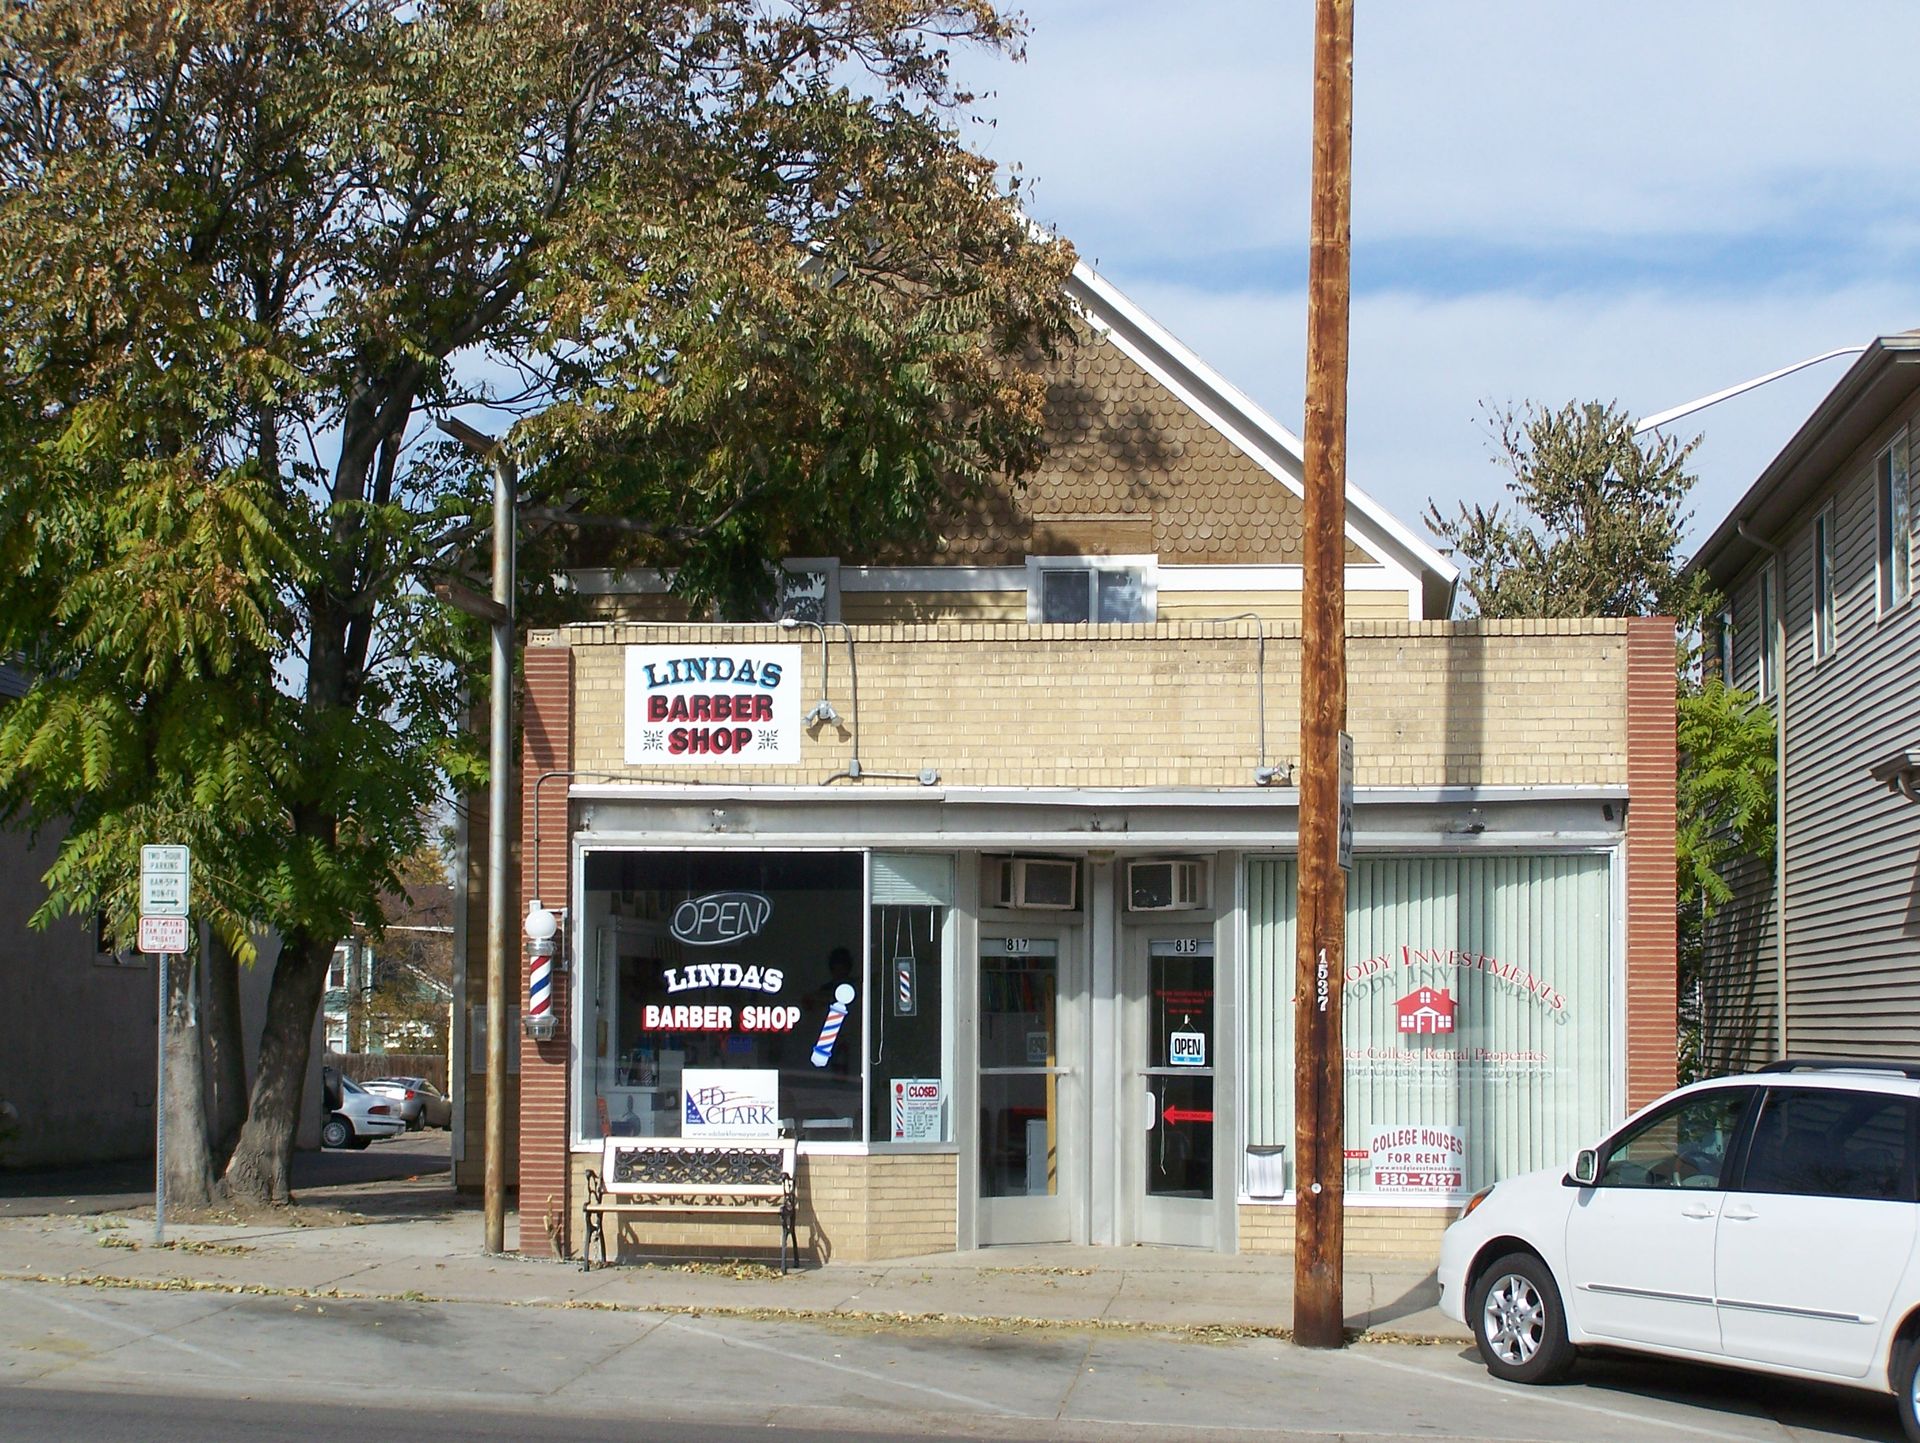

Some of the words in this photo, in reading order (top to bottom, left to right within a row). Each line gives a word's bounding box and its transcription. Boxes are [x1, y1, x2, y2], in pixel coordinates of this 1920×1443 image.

[643, 657, 783, 690] LINDA'S
[648, 694, 774, 722] BARBER
[668, 727, 753, 755] SHOP
[1340, 803, 1352, 854] 25
[148, 852, 160, 860] TWO
[674, 902, 763, 935] OPEN
[1007, 939, 1028, 951] 817
[1175, 940, 1196, 952] 815
[664, 963, 784, 993] LINDA'S
[1317, 948, 1329, 1012] 1537
[1402, 945, 1567, 1010] INVESTMENTS
[643, 1005, 733, 1032] BARBER
[740, 1006, 801, 1032] SHOP
[1174, 1037, 1201, 1056] OPEN
[1367, 1047, 1418, 1064] College
[1425, 1047, 1469, 1061] Rental
[1475, 1048, 1548, 1065] Properties
[700, 1087, 725, 1106] ED
[909, 1086, 938, 1098] CLOSED
[706, 1106, 775, 1124] CLARK
[1372, 1129, 1418, 1153] COLLEGE
[1421, 1129, 1463, 1155] HOUSES
[1387, 1153, 1411, 1163] FOR
[1415, 1153, 1447, 1164] RENT
[1380, 1173, 1455, 1185] 330-7427
